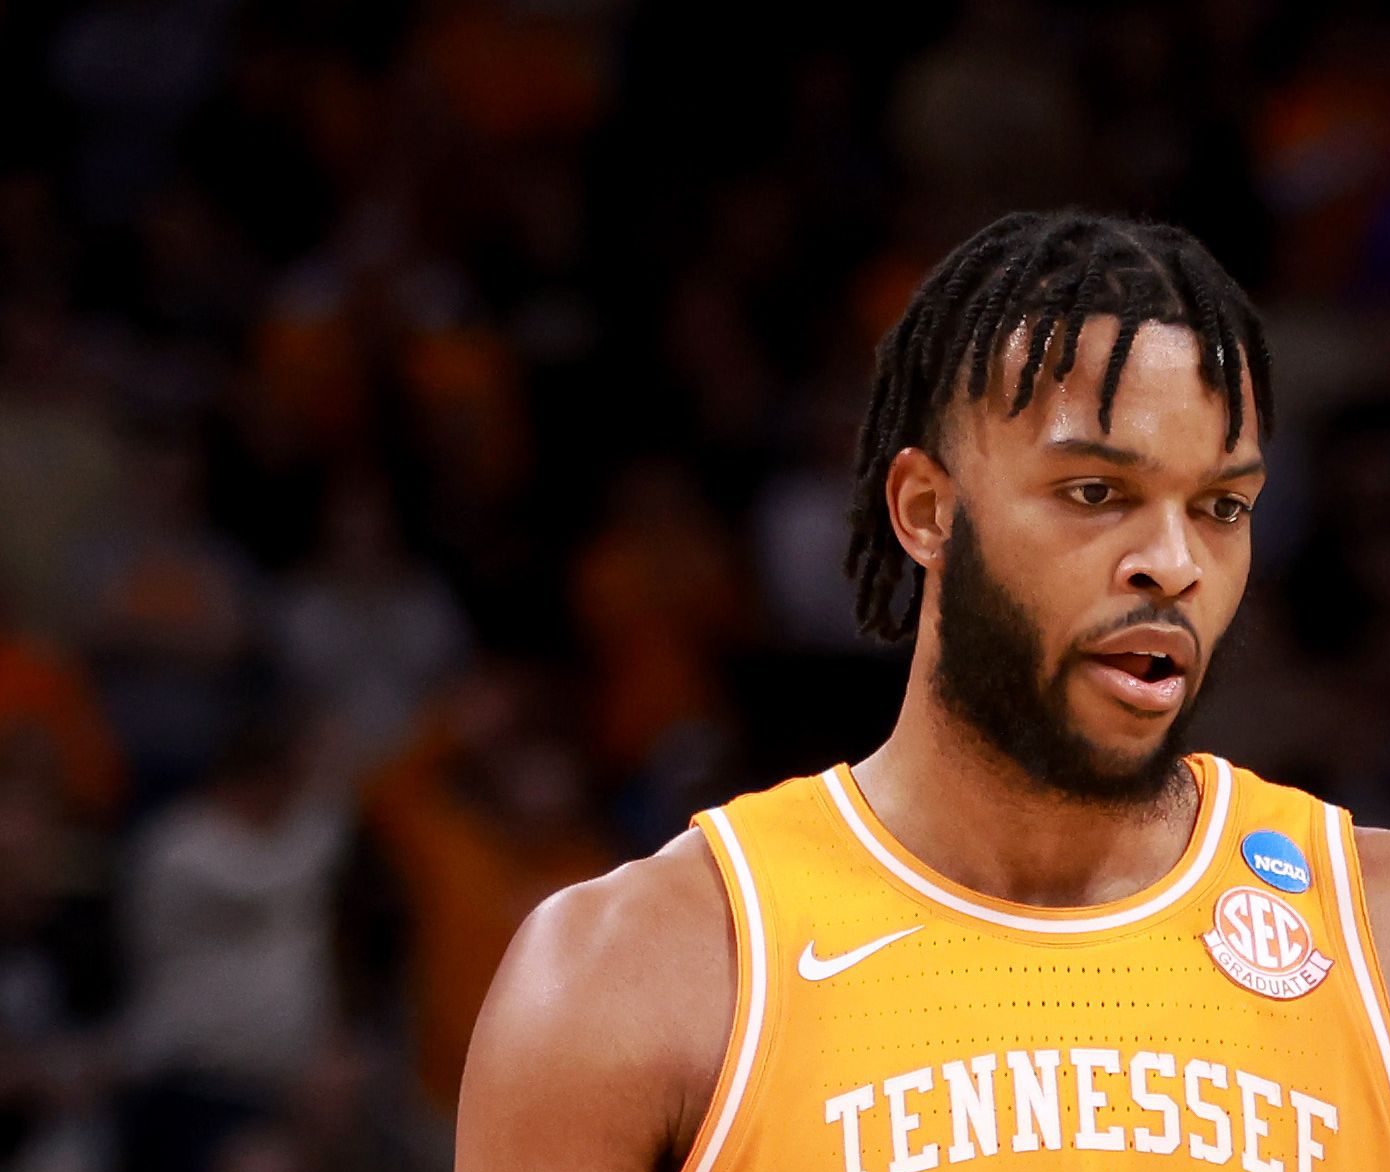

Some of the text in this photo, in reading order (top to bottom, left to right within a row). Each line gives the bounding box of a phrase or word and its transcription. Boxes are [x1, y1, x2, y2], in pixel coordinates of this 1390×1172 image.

[1253, 854, 1308, 884] NCAA
[1223, 892, 1302, 969] SEC
[1218, 951, 1317, 996] GRADUATE
